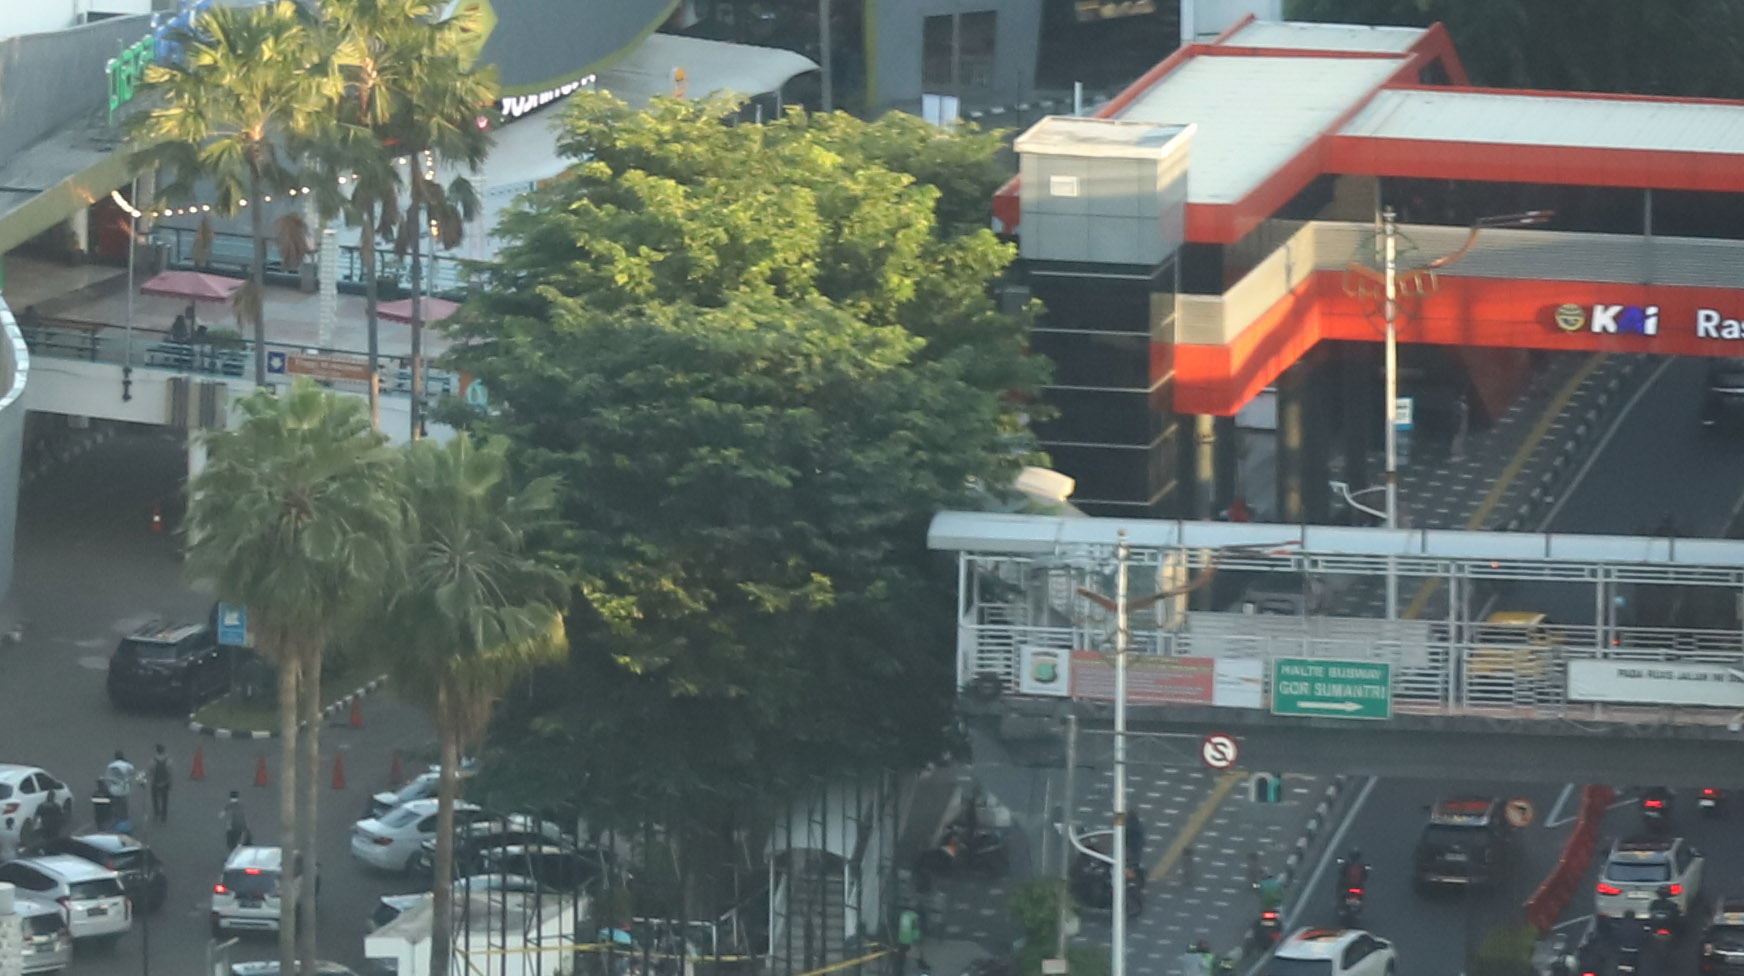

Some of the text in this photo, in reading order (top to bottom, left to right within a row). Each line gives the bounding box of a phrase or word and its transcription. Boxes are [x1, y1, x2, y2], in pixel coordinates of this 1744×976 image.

[1281, 664, 1382, 679] HALTE BUSWAY
[1279, 680, 1386, 699] GOR SUMANTRI
